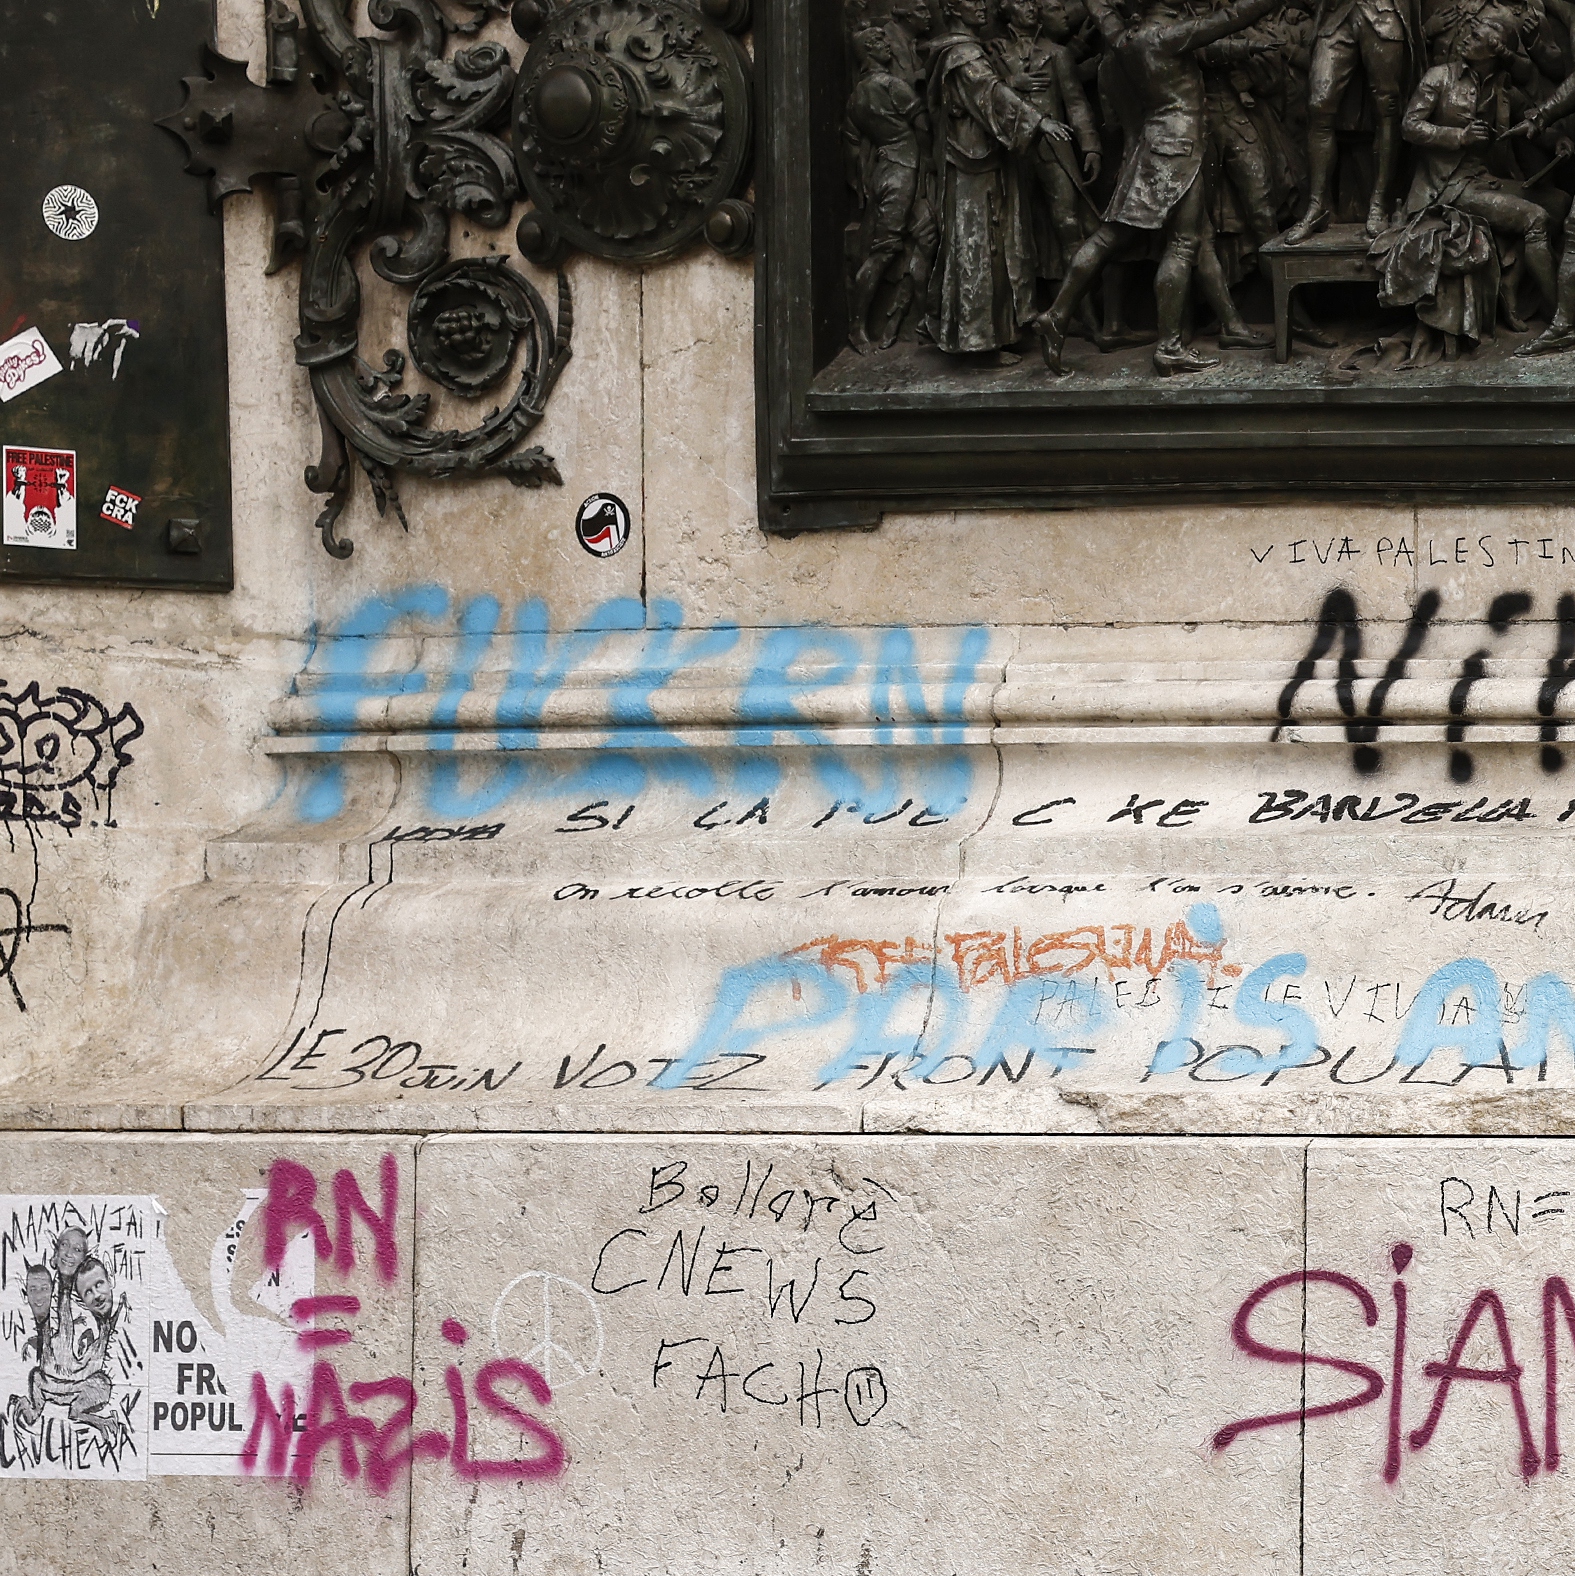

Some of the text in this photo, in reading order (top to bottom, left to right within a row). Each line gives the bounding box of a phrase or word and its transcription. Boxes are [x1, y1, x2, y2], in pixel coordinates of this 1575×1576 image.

[7, 451, 74, 467] FREE PALESTINE
[102, 503, 133, 525] CRA
[106, 489, 140, 514] FCK
[555, 799, 636, 833] SI
[1011, 797, 1077, 828] C
[1107, 793, 1210, 828] KE
[552, 882, 600, 901] On
[609, 877, 778, 901] récolte
[259, 1027, 347, 1080] LE
[264, 1152, 402, 1286] RN
[1, 1200, 108, 1291] MAMAN
[110, 1243, 146, 1283] FAIT
[592, 1228, 878, 1325] CNEWS
[2, 1309, 26, 1351] UN
[152, 1321, 206, 1353] NO
